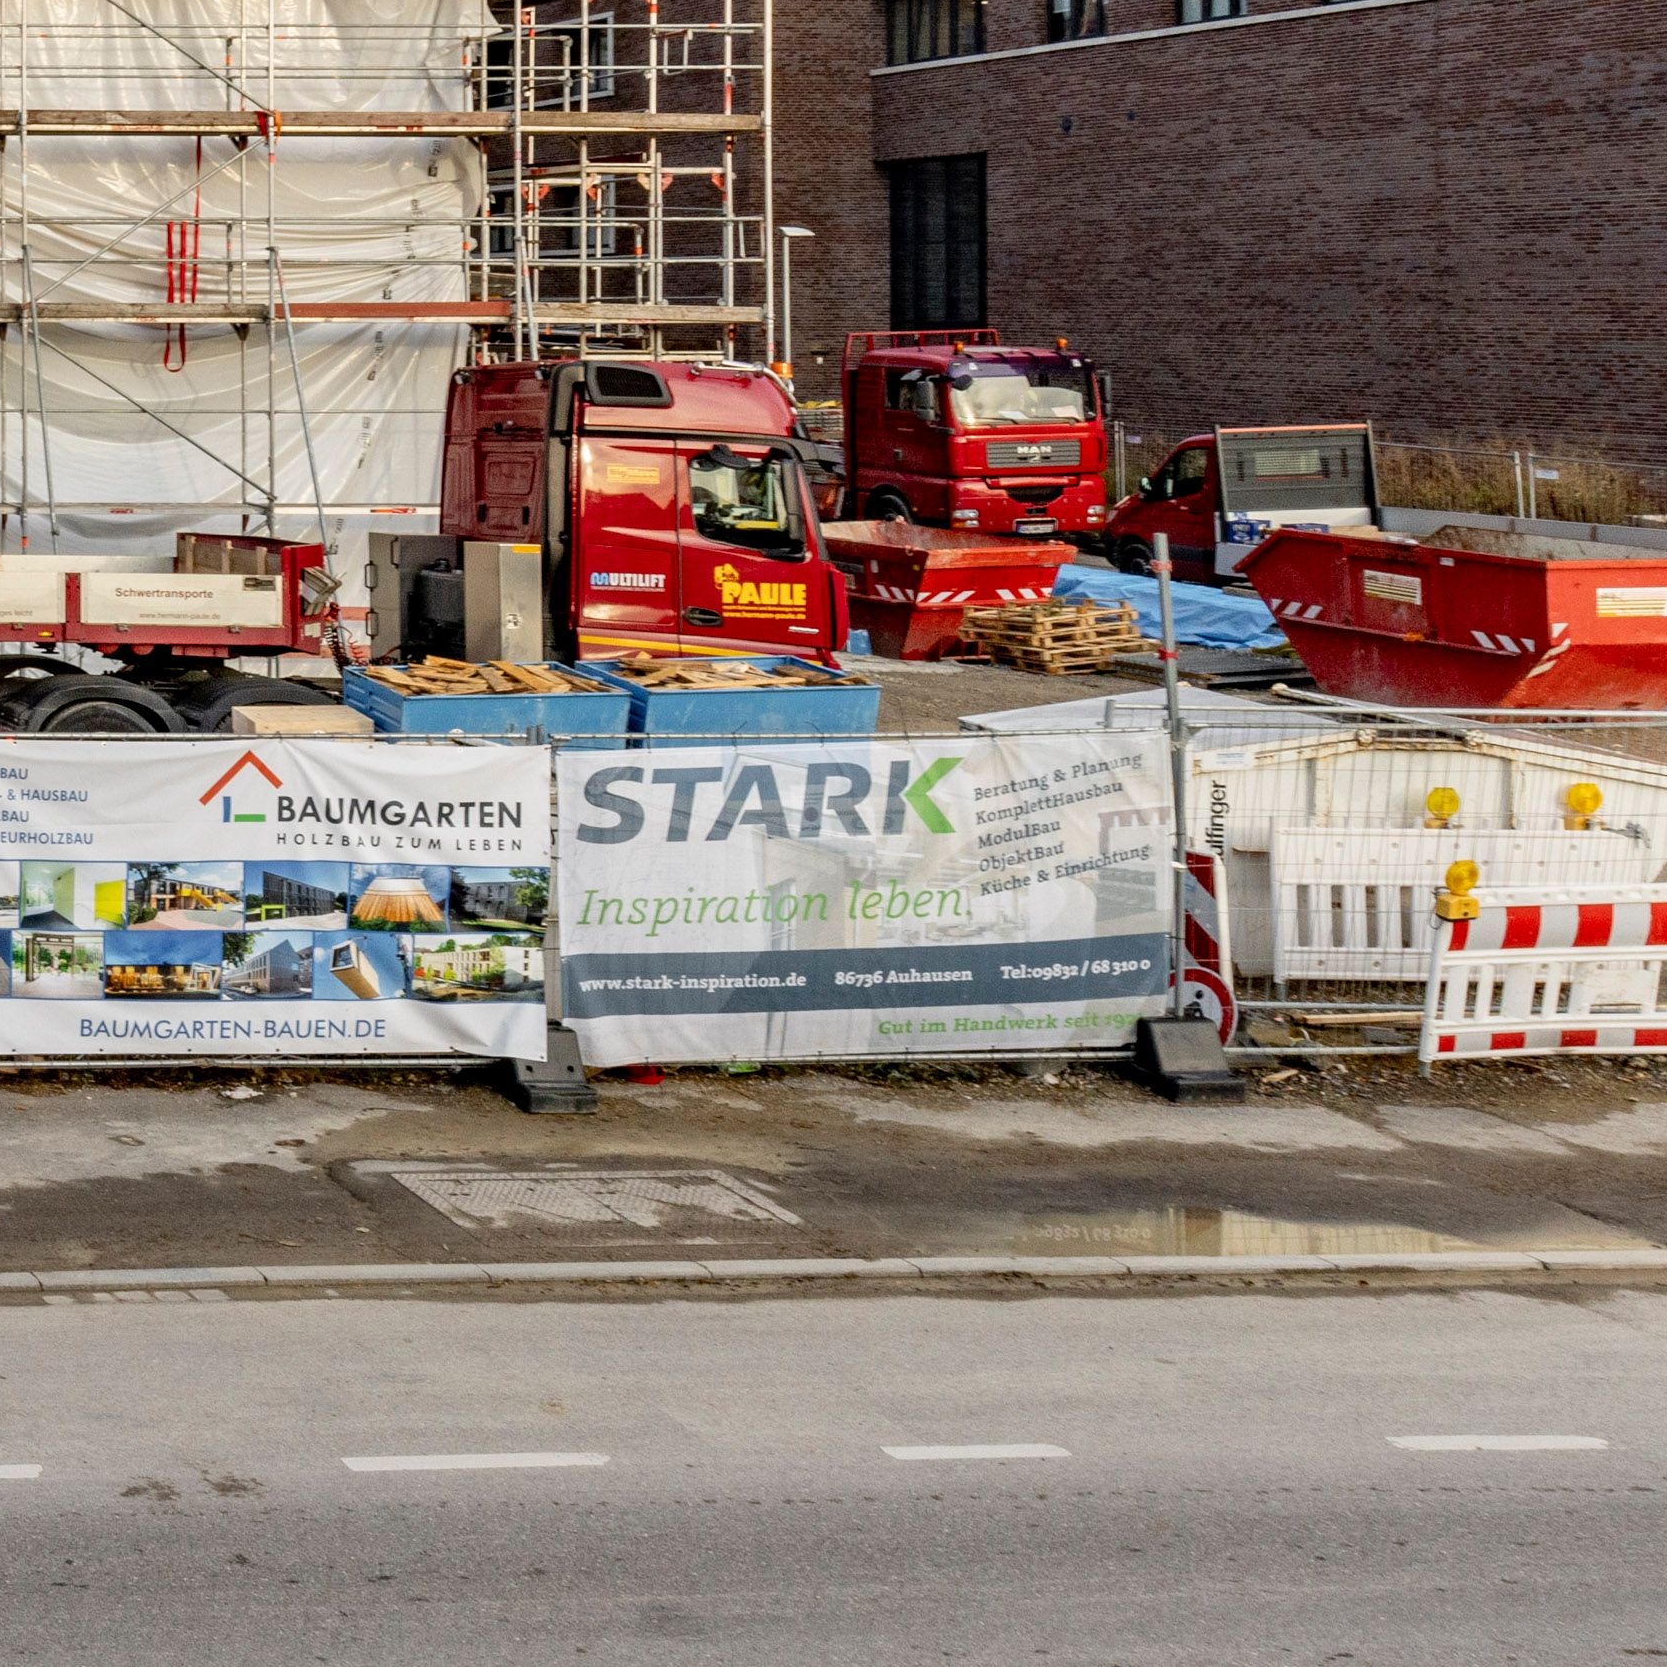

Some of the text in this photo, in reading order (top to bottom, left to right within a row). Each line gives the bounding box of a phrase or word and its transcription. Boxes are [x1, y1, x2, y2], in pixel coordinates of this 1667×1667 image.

[1017, 446, 1052, 454] MAN
[590, 572, 666, 587] MULTILIFT
[115, 588, 214, 600] Schwertransporte
[722, 582, 806, 605] PAULE
[974, 753, 1144, 801] Beratung & Planung
[6, 789, 18, 802] &
[20, 788, 89, 804] HAUSBAU
[576, 757, 964, 844] STARK
[975, 782, 1124, 825] KomplettHausbau
[277, 795, 522, 829] BAUMGARTEN
[277, 833, 522, 852] HOLZBAU ZUM LEBEN
[978, 820, 1062, 849] ModulBau
[979, 841, 1065, 872] ObjektBau
[980, 844, 1152, 896] Küche & Einrichtung
[577, 879, 973, 937] Inspiration leben.
[580, 971, 807, 993] www.stark-inspiration.de
[835, 966, 973, 988] 86736 Auhausen
[1000, 963, 1079, 980] Tel:09832
[79, 1018, 386, 1041] BAUMGARTEN-BAUEN.DE
[879, 1019, 913, 1036] Gut
[921, 1018, 947, 1034] im
[955, 1013, 1057, 1032] Handwerk
[1064, 1012, 1099, 1028] seit
